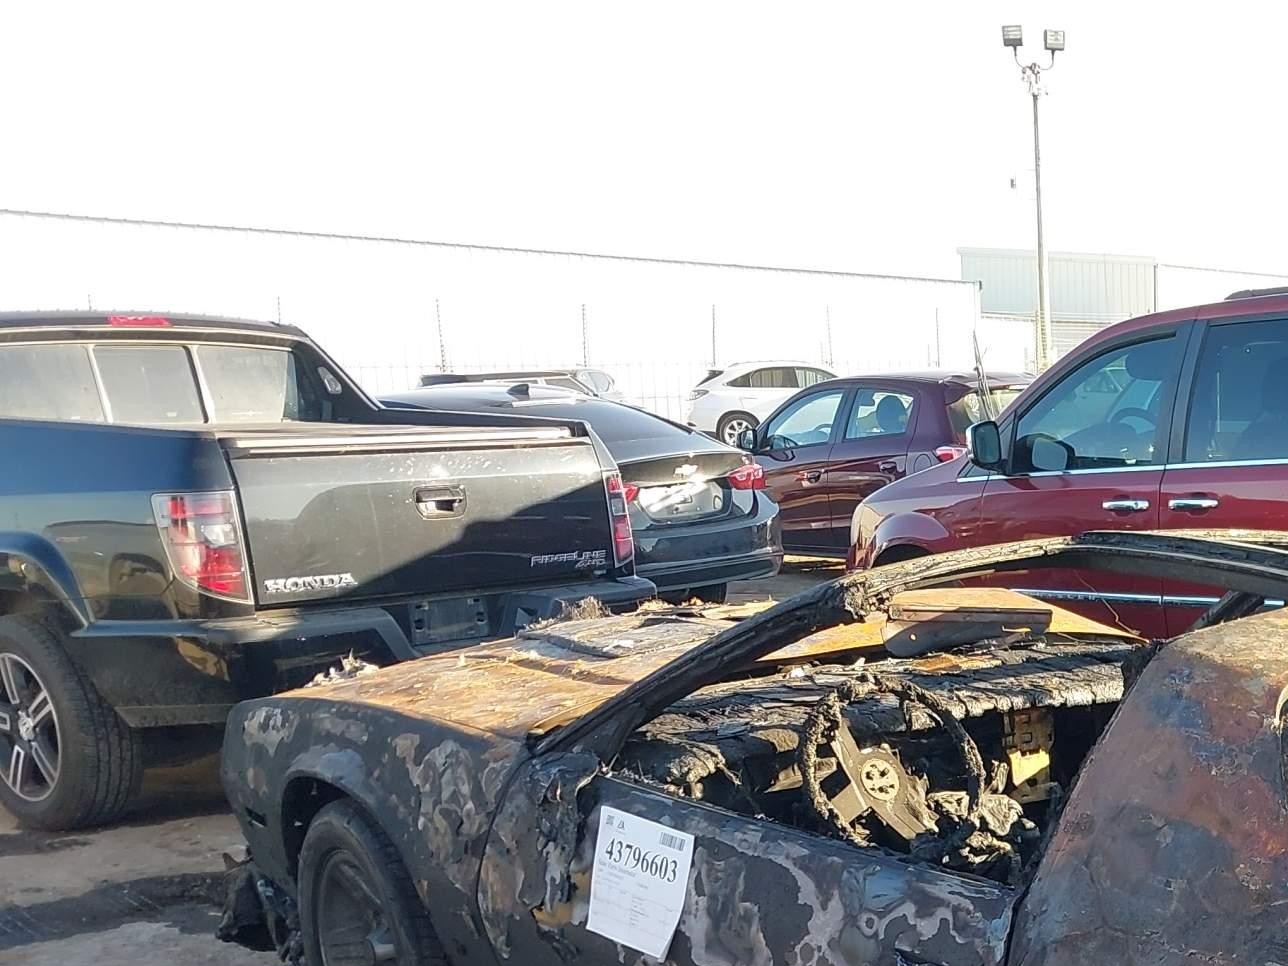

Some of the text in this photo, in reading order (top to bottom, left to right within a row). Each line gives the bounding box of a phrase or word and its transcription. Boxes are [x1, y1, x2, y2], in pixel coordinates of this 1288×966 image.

[530, 550, 607, 566] RIDGELINE
[263, 572, 358, 593] HONDA
[605, 837, 678, 883] 43796603
